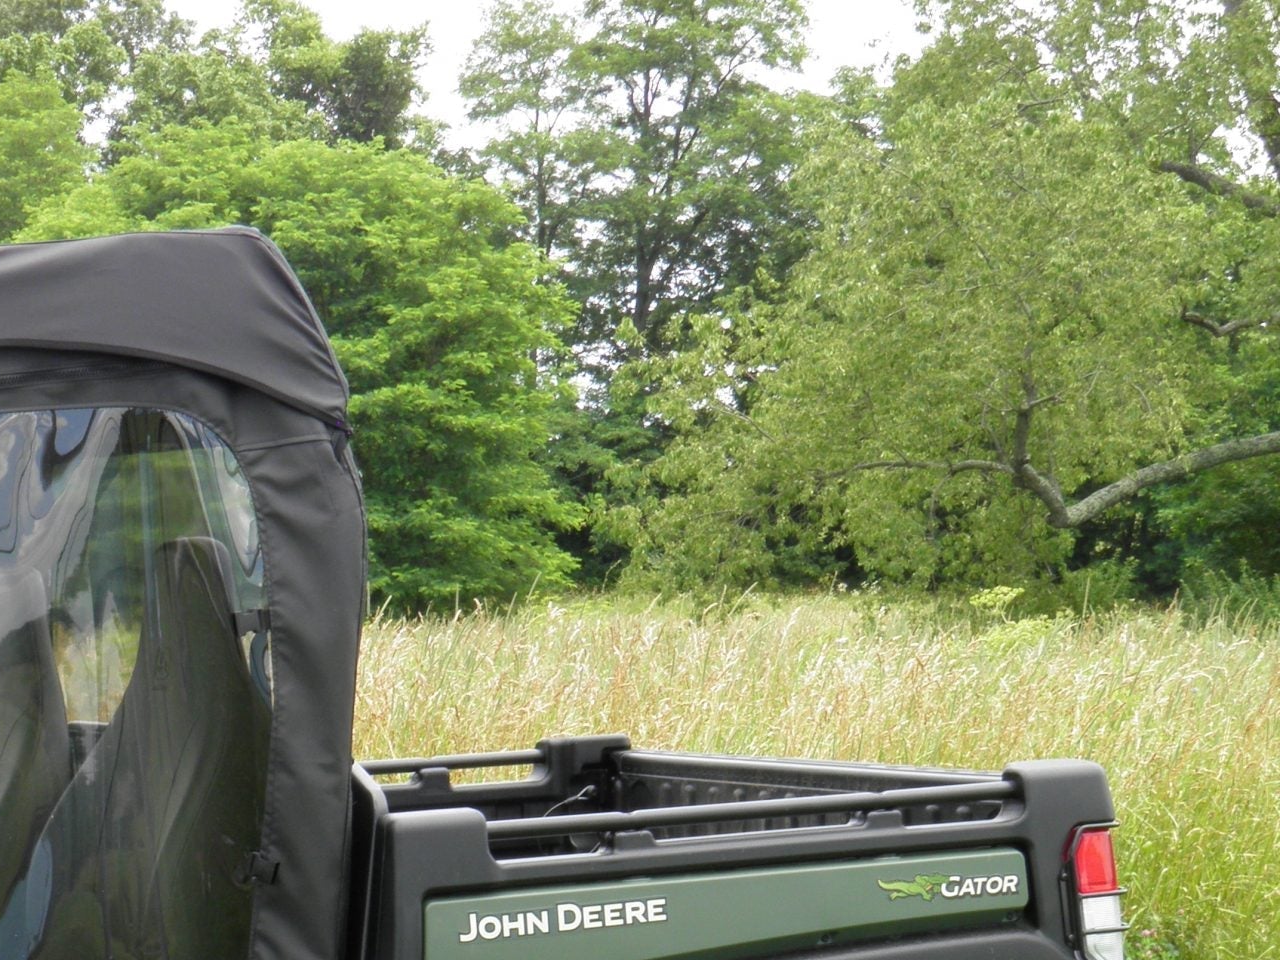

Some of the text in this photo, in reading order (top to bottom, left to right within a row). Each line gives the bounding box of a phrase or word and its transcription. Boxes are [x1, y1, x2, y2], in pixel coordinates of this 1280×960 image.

[940, 874, 1019, 898] GATOR
[458, 898, 668, 943] JOHN DEERE
